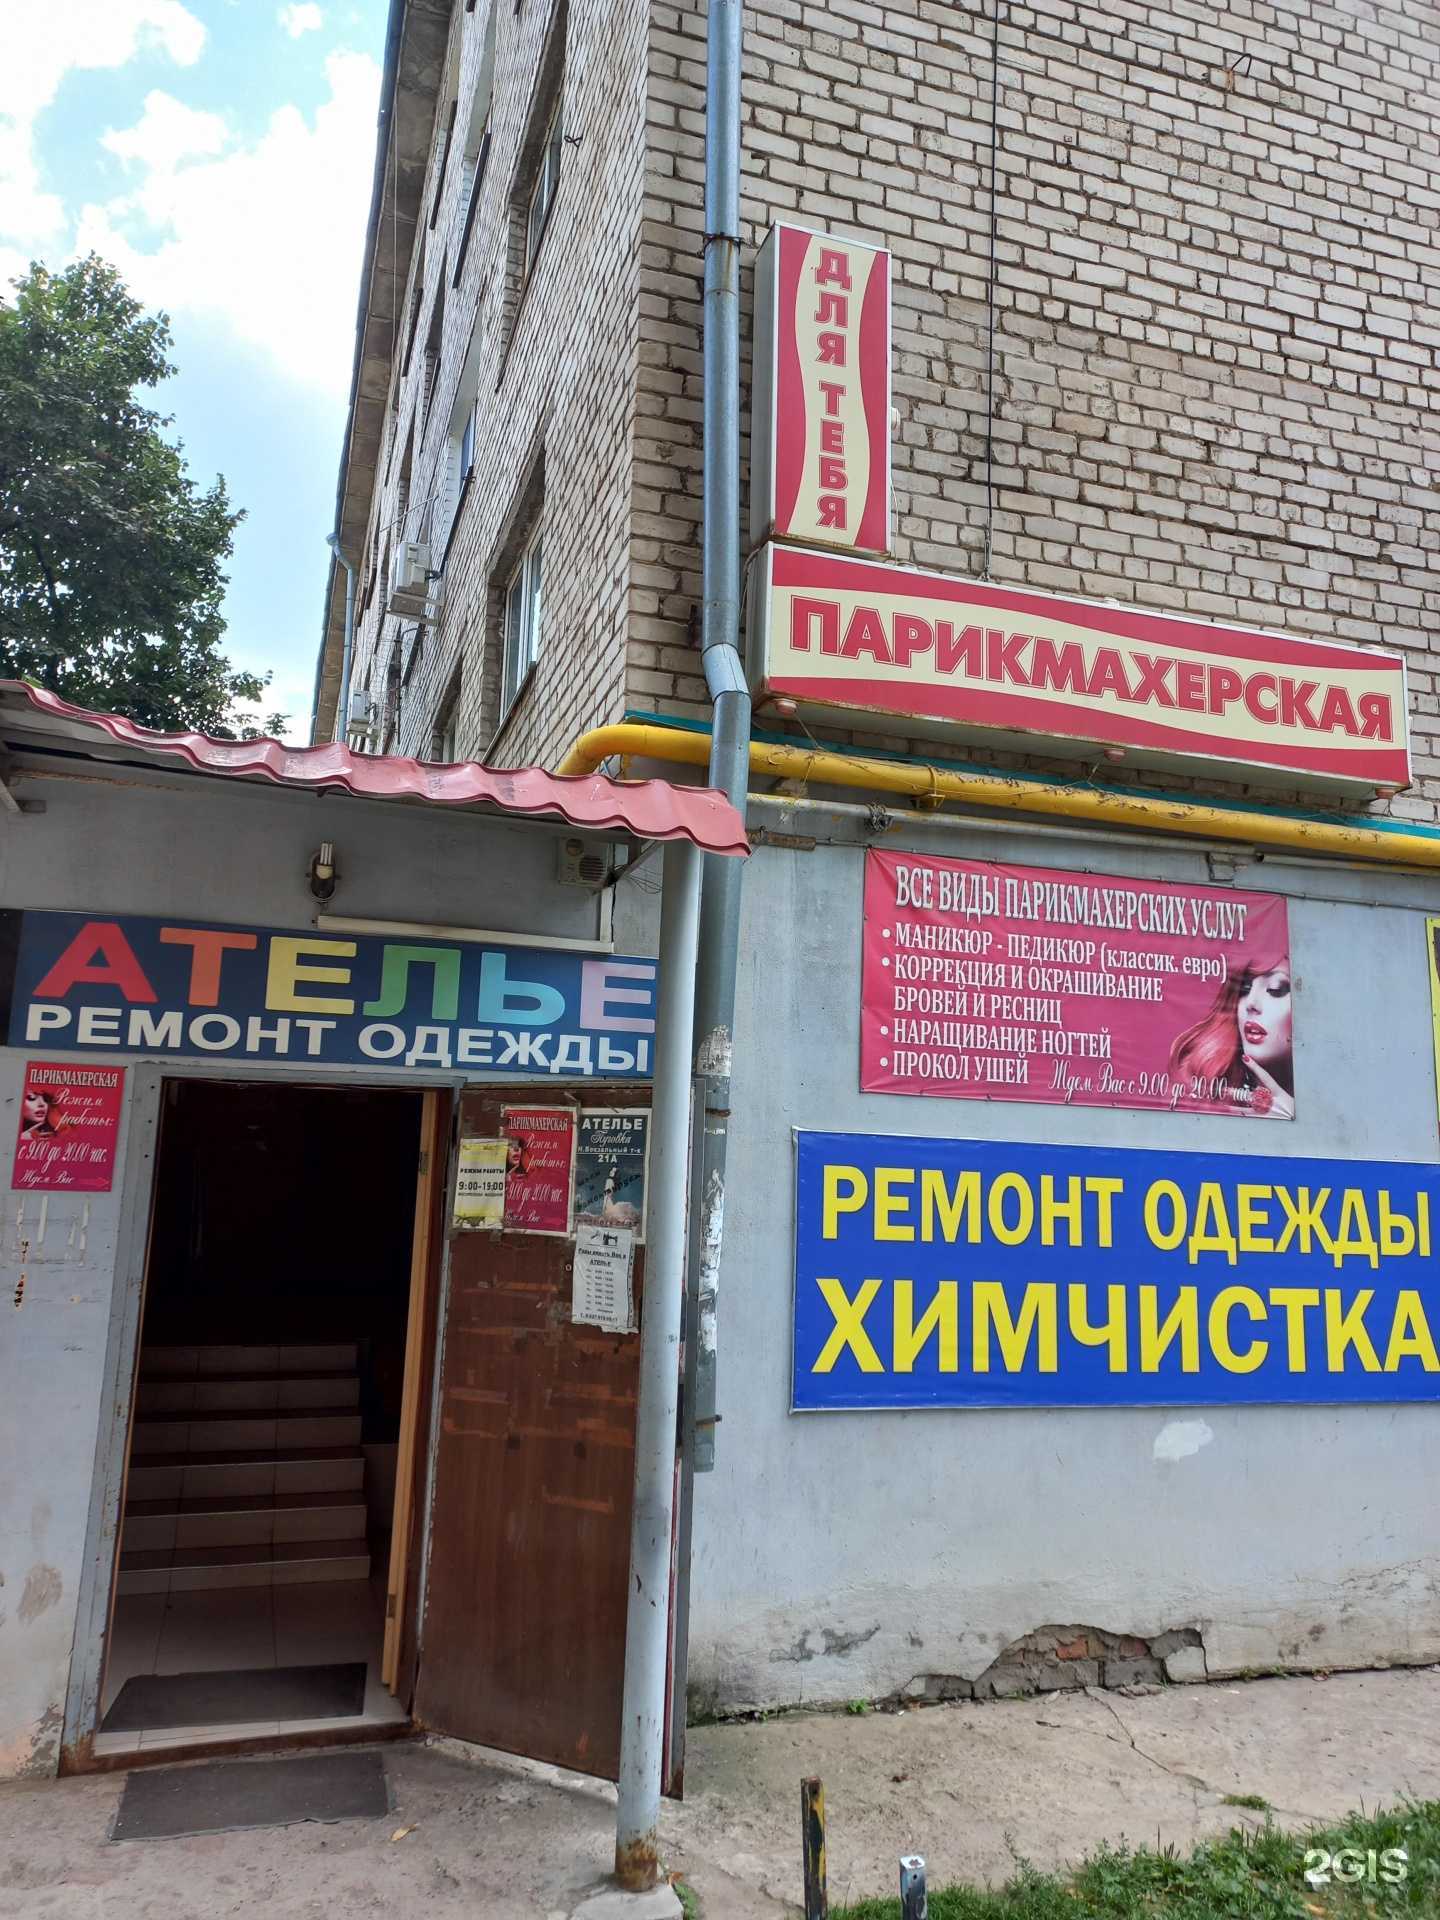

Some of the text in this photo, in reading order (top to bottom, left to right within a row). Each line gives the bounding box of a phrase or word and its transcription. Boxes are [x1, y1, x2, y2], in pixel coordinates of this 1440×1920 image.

[814, 247, 853, 532] ДЛЯ ТЕБЯ
[789, 594, 1394, 744] ПАРИКМАХЕРСКАЯ
[896, 866, 1247, 942] ВСЕ ВИДЫ ПАРИКМАХЕРСКИХ УСЛУГ
[895, 922, 992, 955] МАНИКЮР
[1007, 933, 1096, 965] ПЕДИКЮР
[1100, 942, 1179, 974] (классик.
[1182, 953, 1227, 984] евро)
[32, 921, 656, 1034] АТЕЛЬЕ
[894, 954, 1163, 1001] КОРРЕКЦИЯ И ОКРАШИВАНИЕ
[894, 984, 1063, 1028] БРОВЕЙ И РЕСНИЦ
[25, 1003, 337, 1056] РЕМОНТ
[357, 1022, 648, 1075] ОДЕЖДЫ
[893, 1018, 1112, 1058] НАРАЩИВАНИЕ НОГТЕЙ
[30, 1068, 118, 1088] ПАРИКМАХЕРСКАЯ
[892, 1051, 1029, 1084] ПРОКОЛ УШЕЙ
[1097, 1062, 1126, 1092] Вас
[1128, 1080, 1135, 1094] с
[1138, 1071, 1169, 1096] 9.00
[1169, 1082, 1186, 1110] до
[1189, 1075, 1228, 1099] 20.00
[54, 1087, 104, 1107] Режим
[54, 1107, 114, 1132] работы:
[525, 1132, 559, 1151] Режим
[582, 1117, 643, 1130] АТЕЛЬЕ
[41, 1146, 61, 1174] до
[597, 1154, 617, 1163] 21А
[822, 1164, 1124, 1249] РЕМОНТ
[1143, 1178, 1431, 1269] ОДЕЖДЫ
[810, 1277, 1440, 1374] ХИМЧИСТКА
